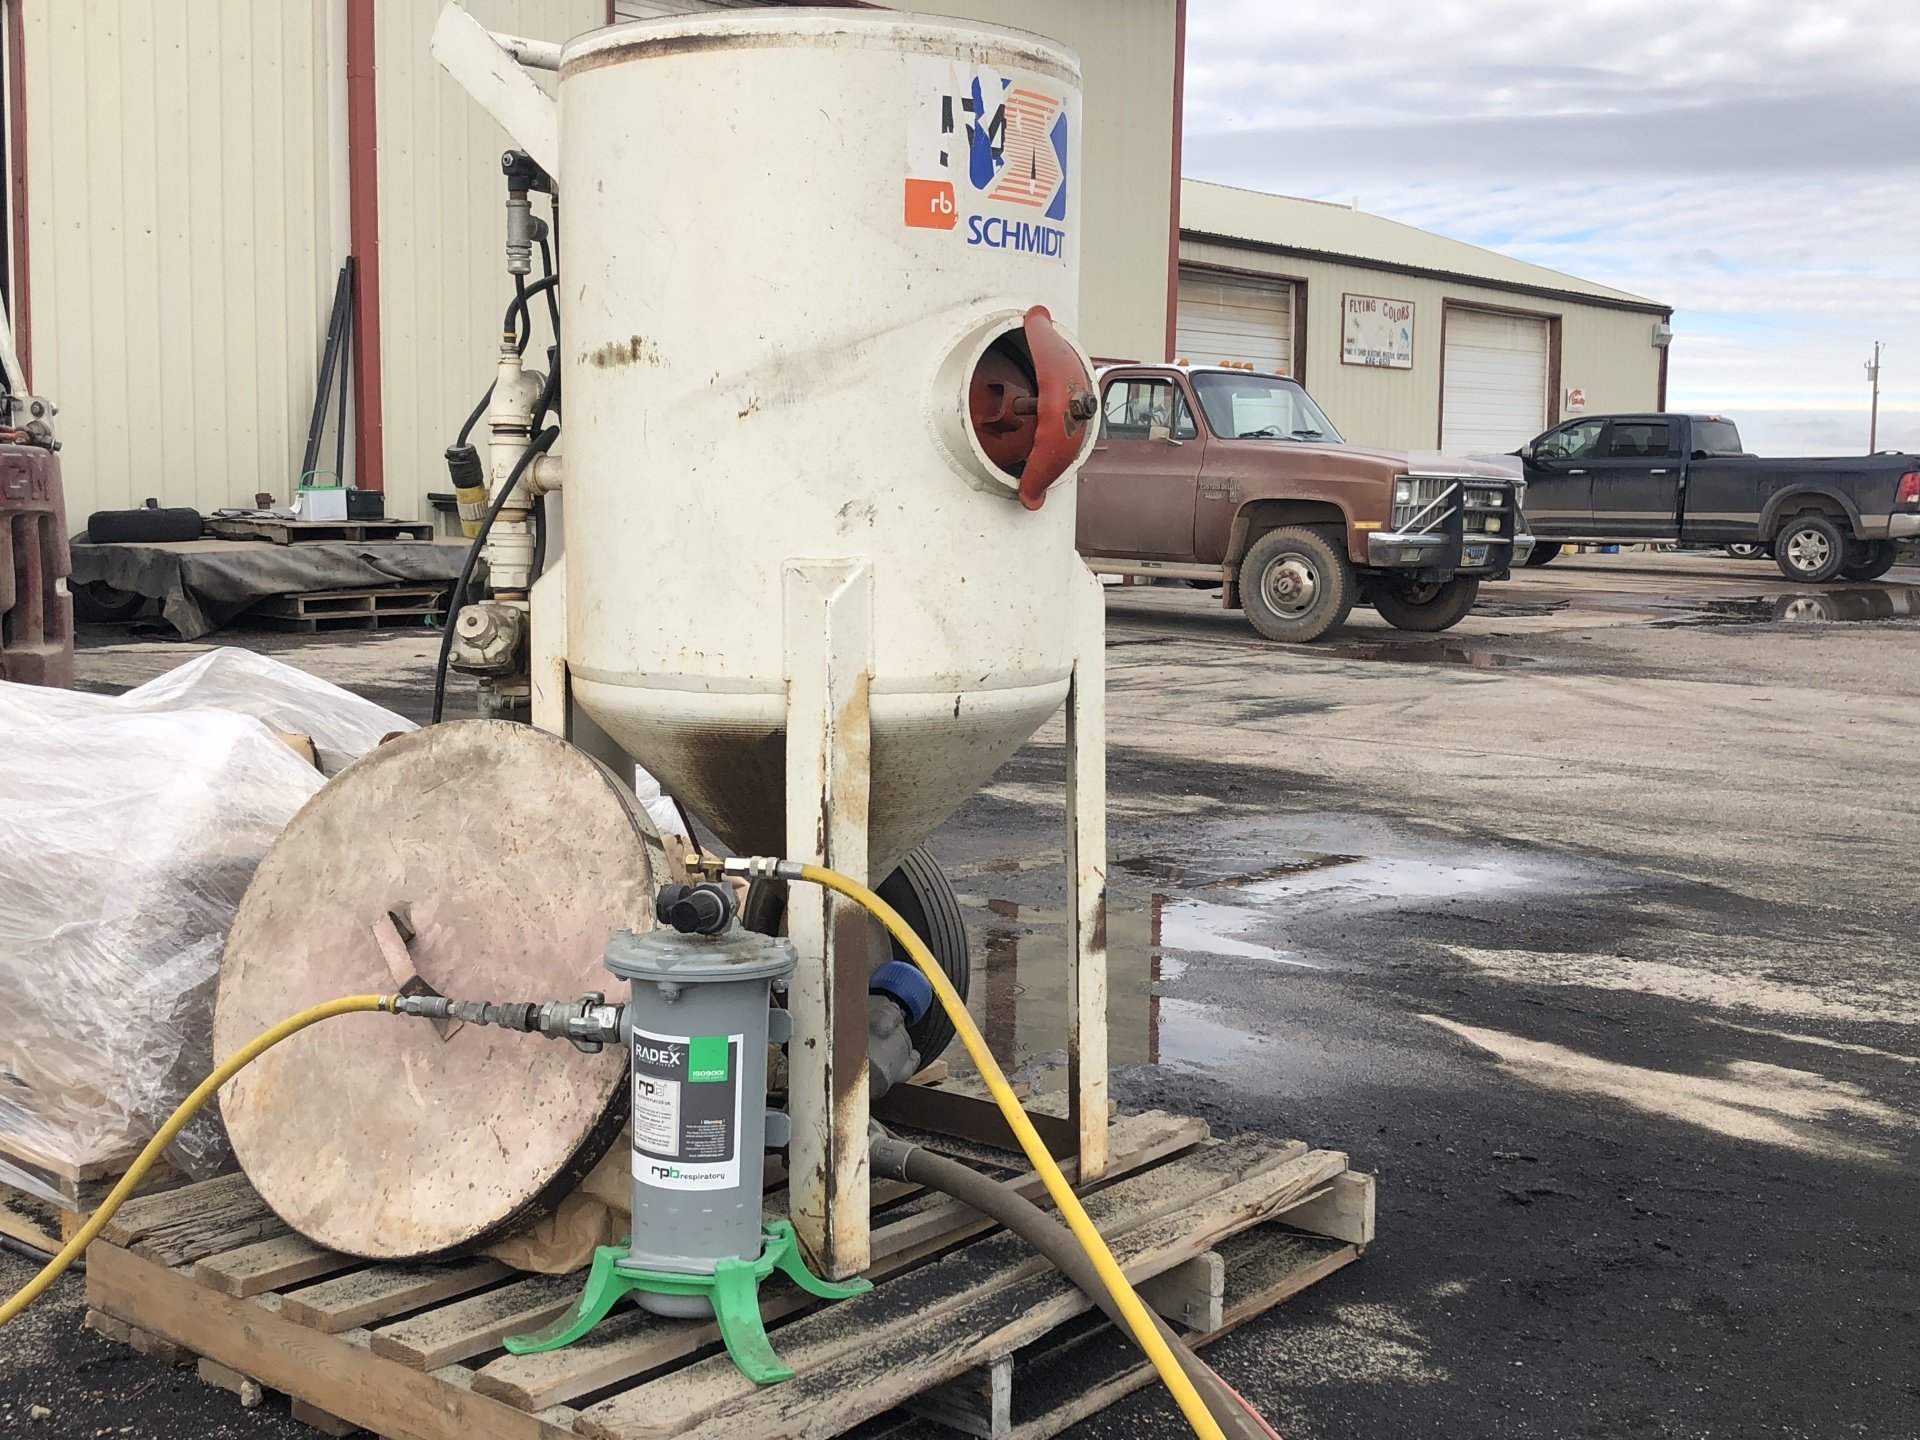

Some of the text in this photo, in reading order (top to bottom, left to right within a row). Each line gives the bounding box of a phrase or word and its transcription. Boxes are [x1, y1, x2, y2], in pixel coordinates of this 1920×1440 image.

[967, 214, 1065, 259] SCHMIDT
[1349, 299, 1410, 323] FLYING COLORS
[635, 1043, 681, 1065] RADEX
[638, 1080, 665, 1097] rpb
[651, 1166, 726, 1182] rpb respiratory
